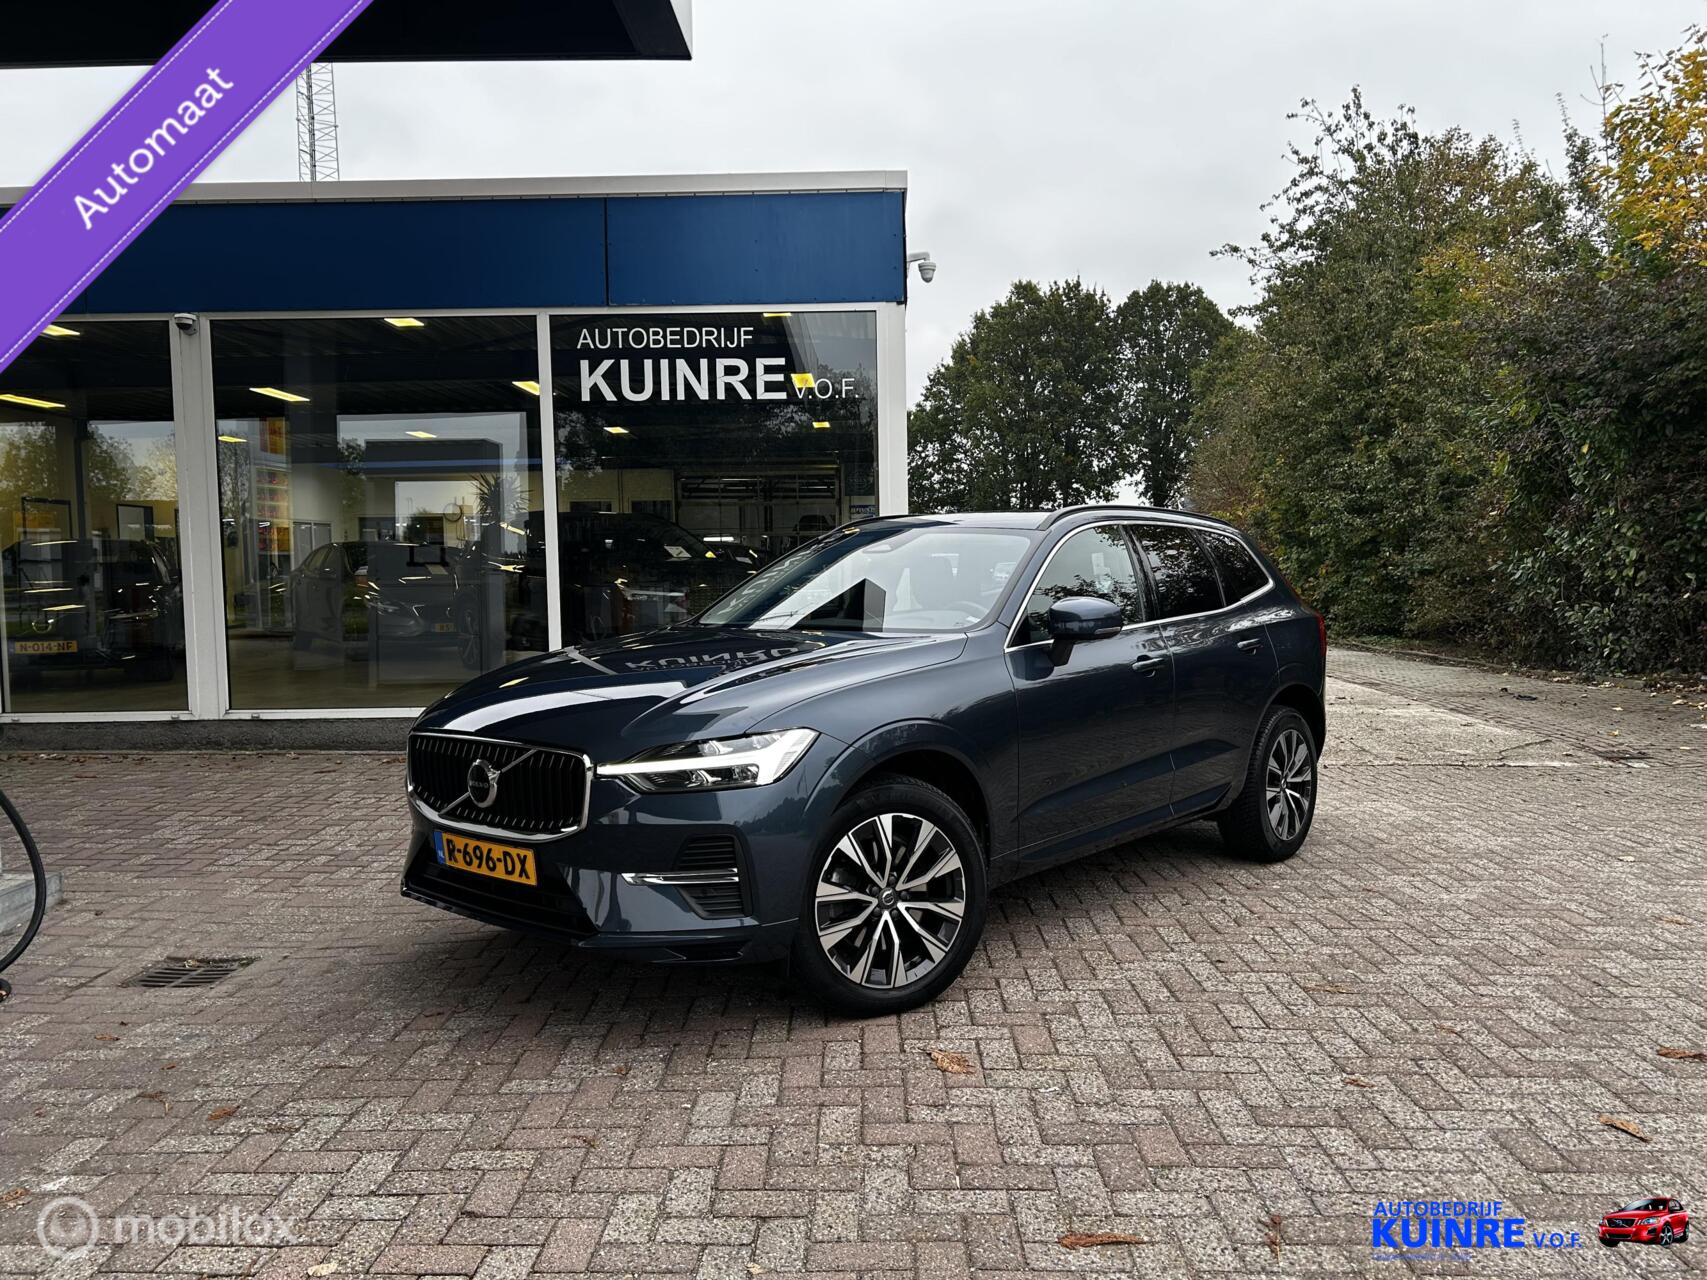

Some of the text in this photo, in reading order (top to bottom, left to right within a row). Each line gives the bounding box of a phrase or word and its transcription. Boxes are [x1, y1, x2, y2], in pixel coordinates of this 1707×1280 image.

[576, 327, 754, 349] AUTOBEDRIJF
[580, 357, 859, 402] KUINRE V.O.F.
[445, 838, 531, 880] R-696-DX
